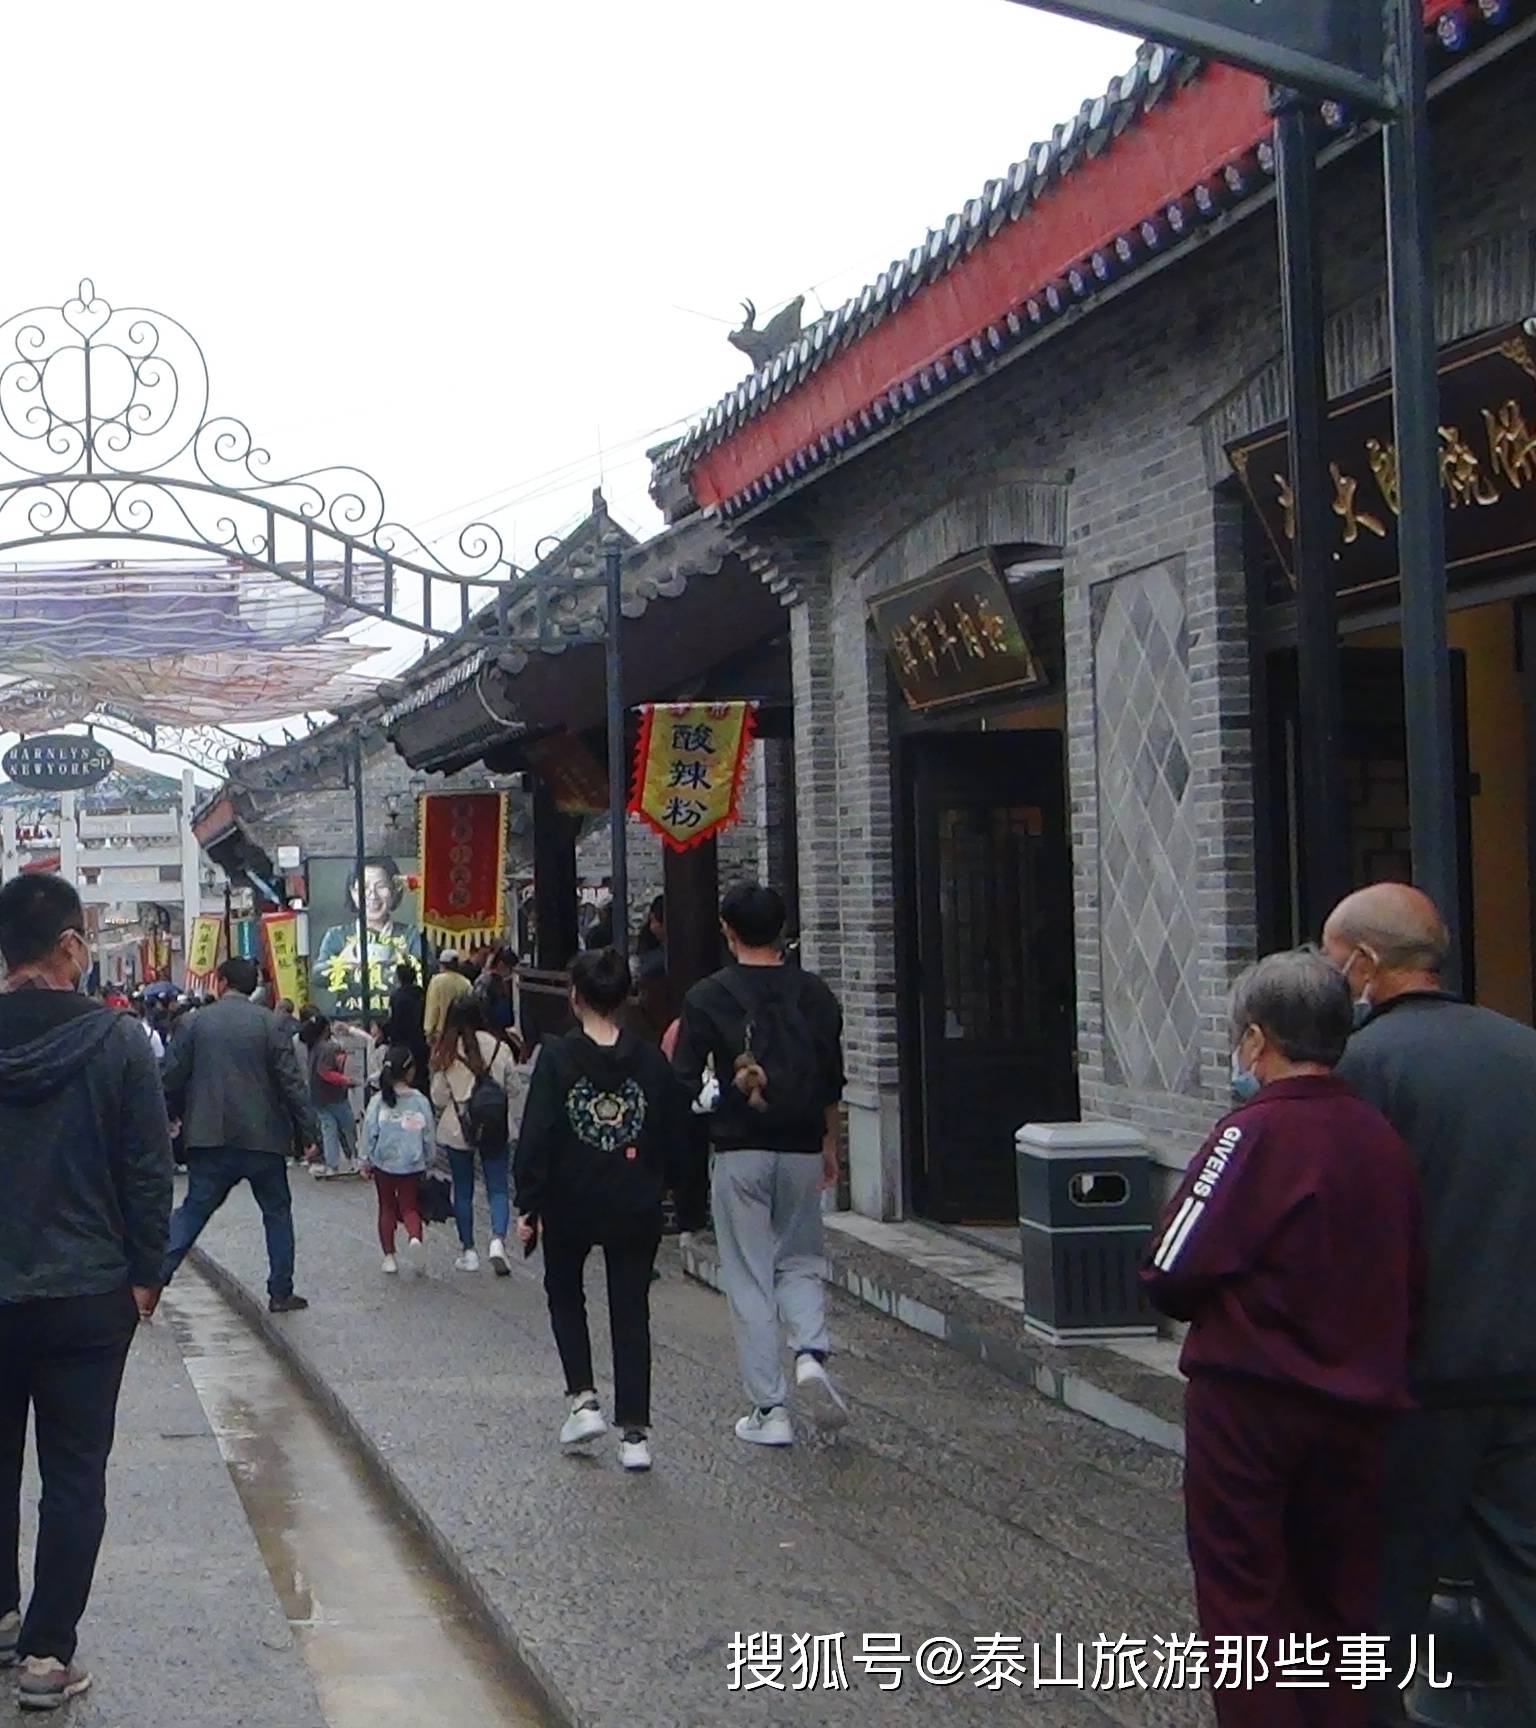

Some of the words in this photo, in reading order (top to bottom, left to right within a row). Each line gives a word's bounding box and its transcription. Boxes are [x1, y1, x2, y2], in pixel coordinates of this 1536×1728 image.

[662, 723, 716, 828] 酸辣粉
[1193, 1126, 1242, 1198] GIVENS
